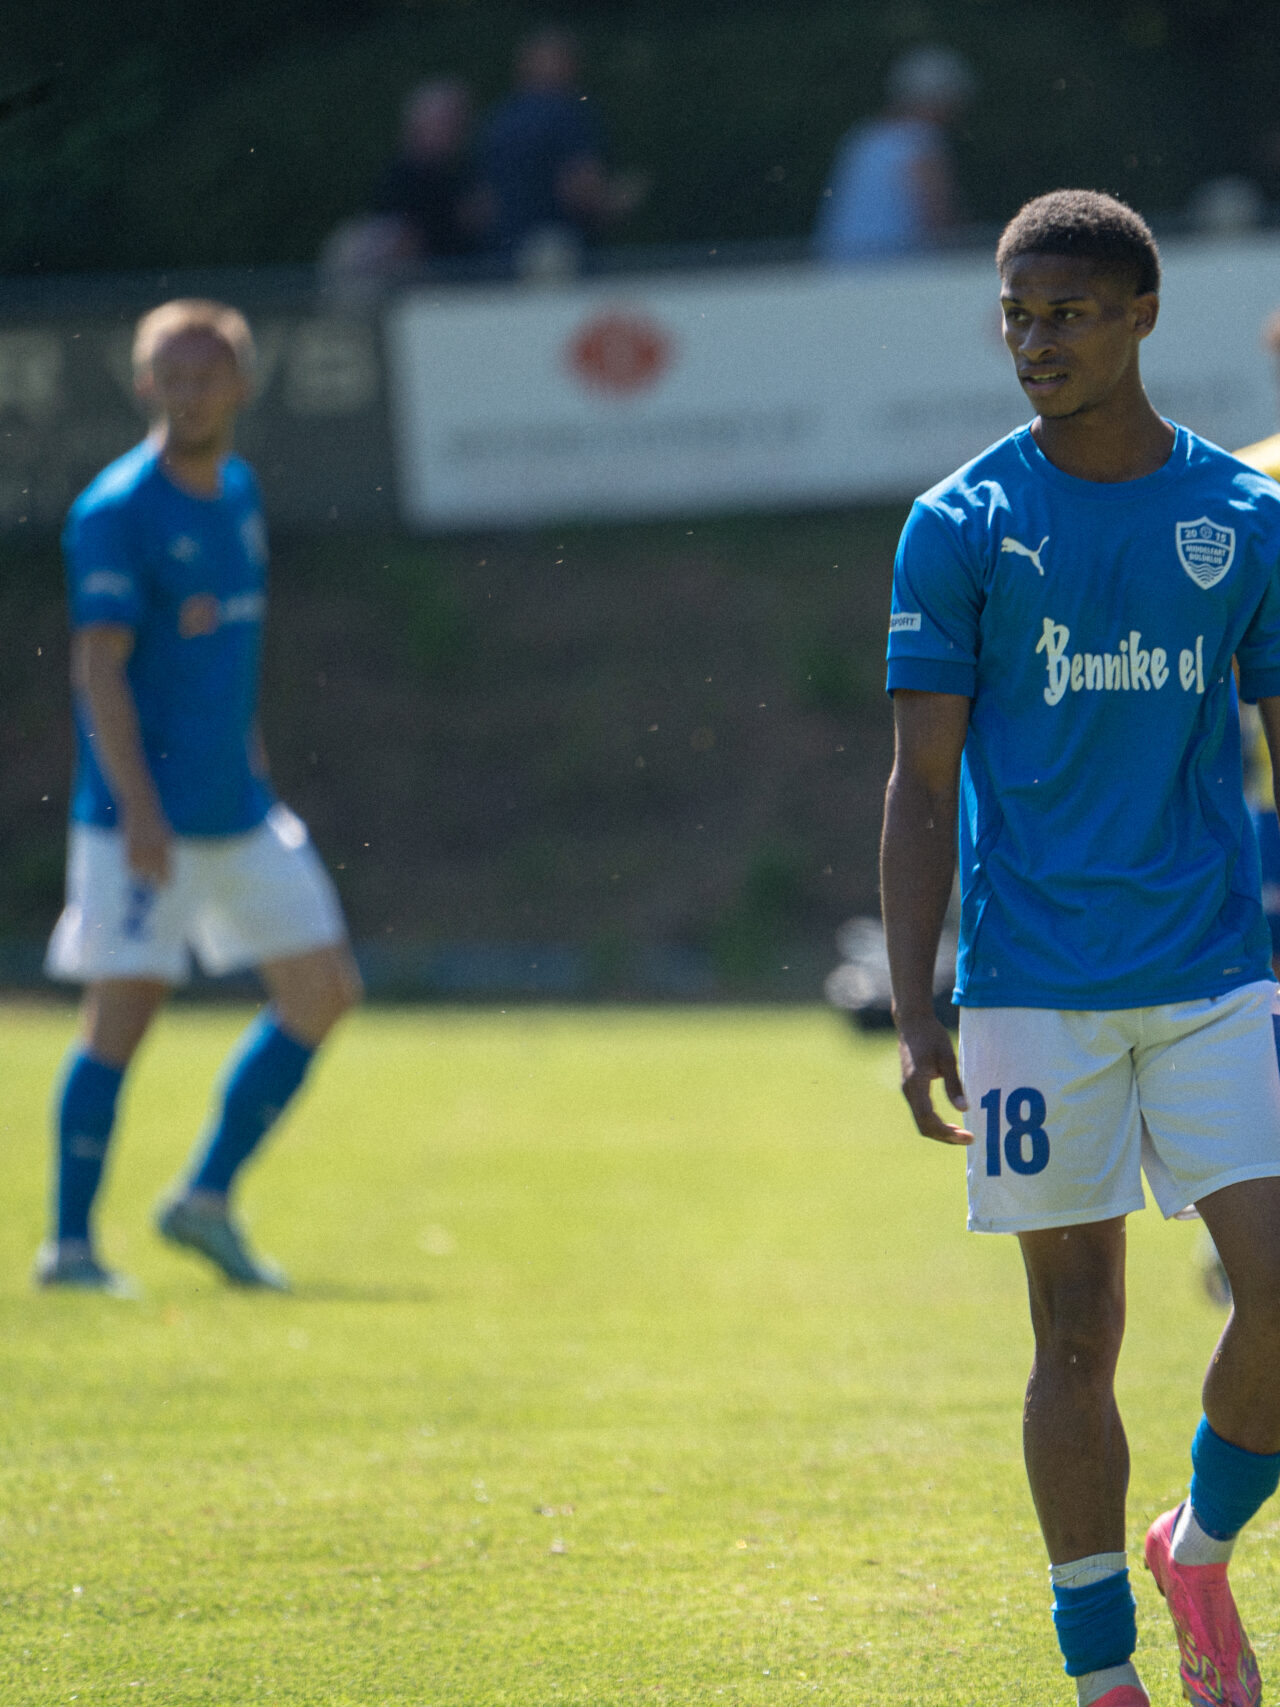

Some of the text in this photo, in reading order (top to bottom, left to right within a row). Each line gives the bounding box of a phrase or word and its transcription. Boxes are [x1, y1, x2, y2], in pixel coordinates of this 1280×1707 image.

[1184, 528, 1198, 539] 20
[1035, 616, 1205, 707] Bennike el
[980, 1086, 1051, 1177] 18
